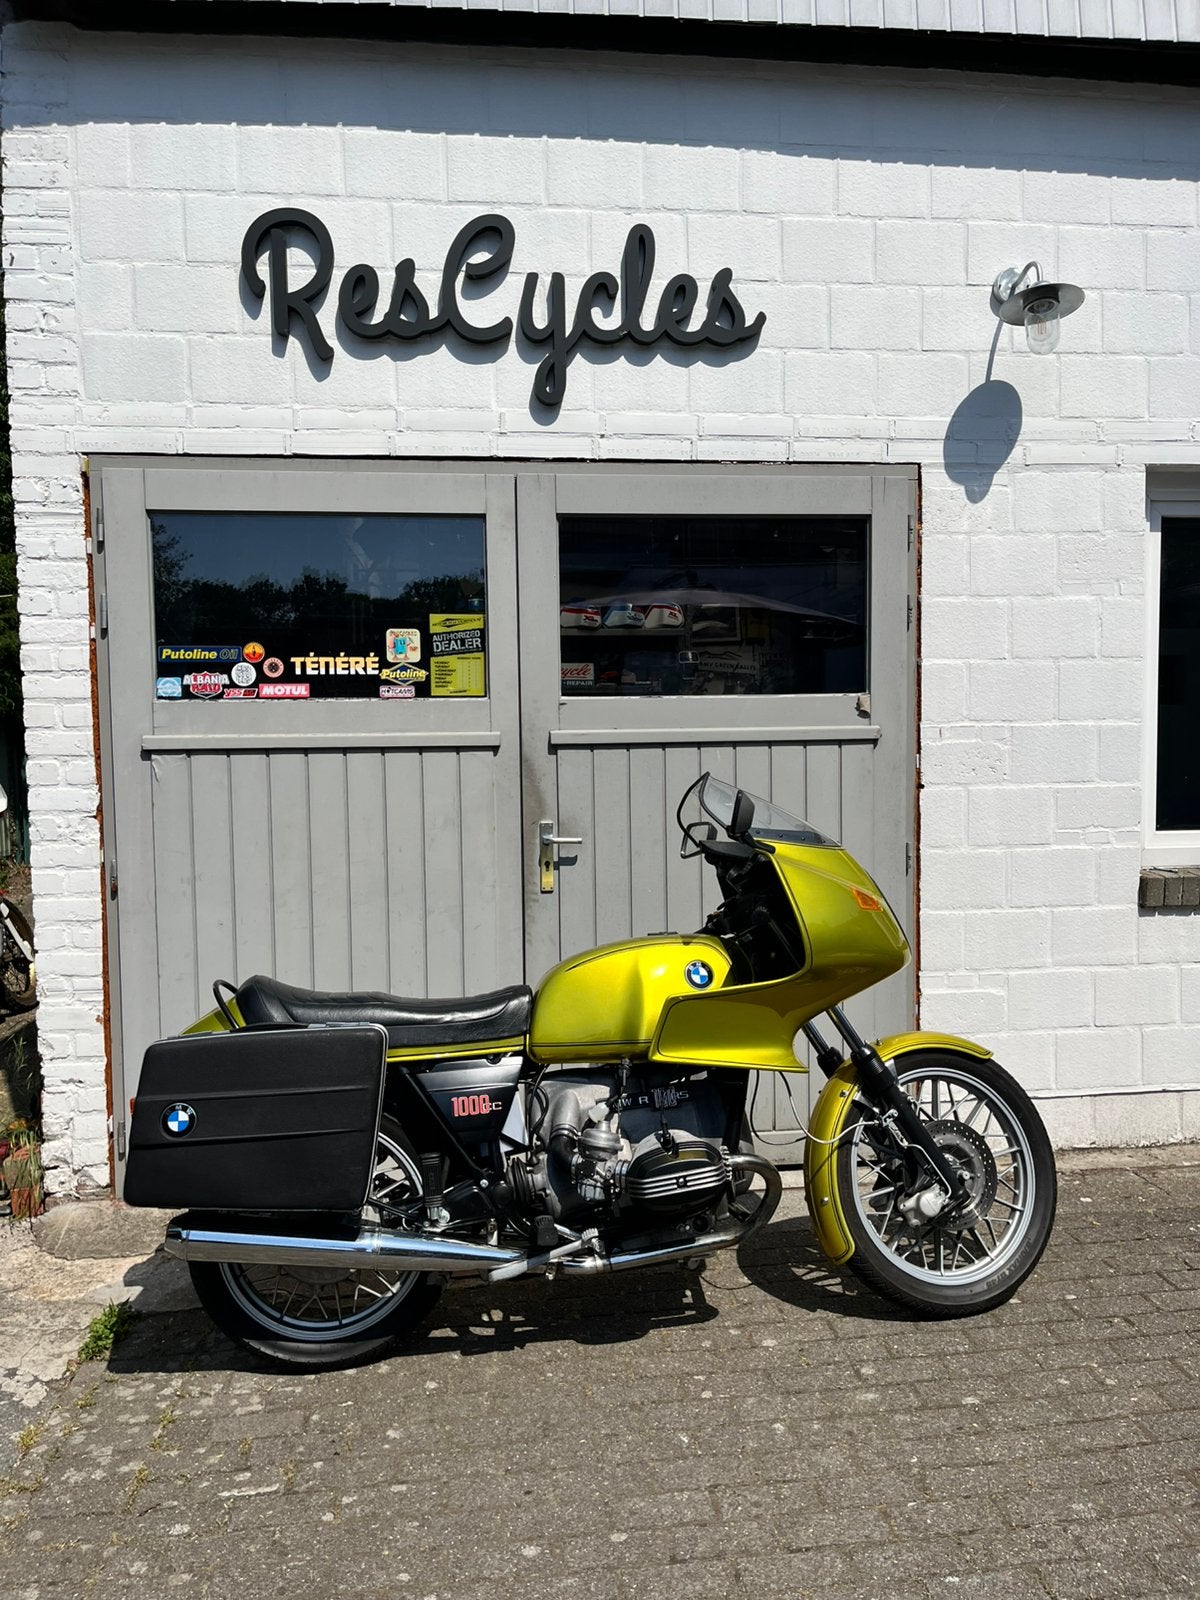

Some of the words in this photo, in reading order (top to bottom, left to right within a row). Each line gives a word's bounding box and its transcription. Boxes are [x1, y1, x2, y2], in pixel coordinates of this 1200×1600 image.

[242, 208, 766, 406] ResCycles
[432, 630, 481, 642] AUTHORIZED
[433, 637, 482, 652] DEALER
[162, 648, 218, 659] Putoline
[182, 674, 230, 685] ALBANIA
[382, 668, 426, 680] Putoline
[191, 683, 221, 693] RAID
[262, 685, 308, 695] MOTUL
[638, 1095, 650, 1105] R
